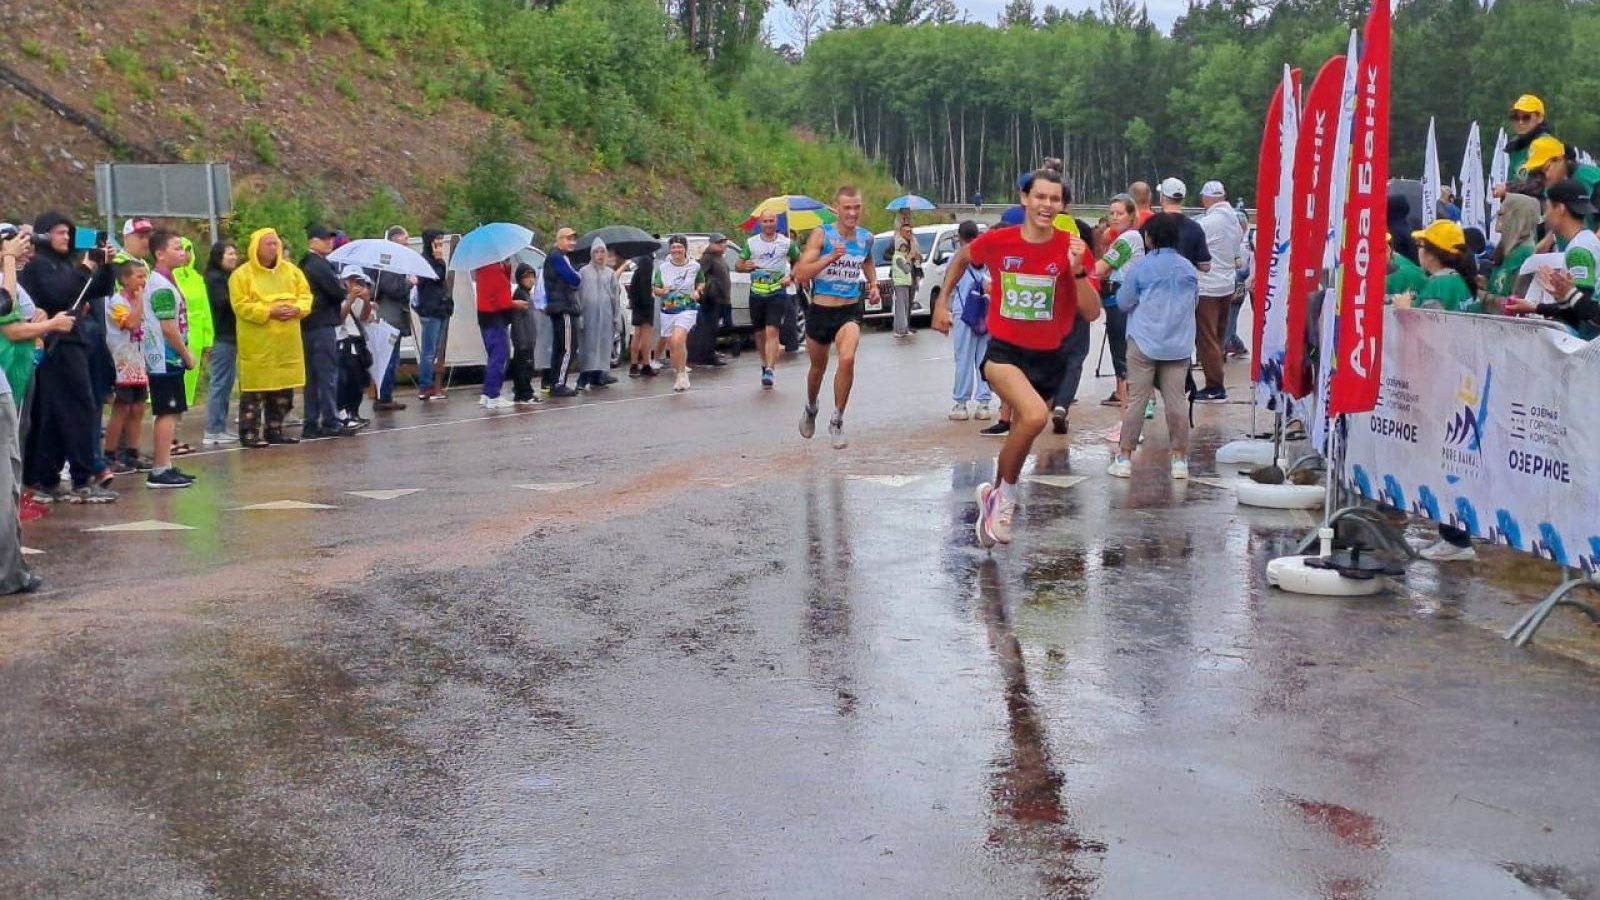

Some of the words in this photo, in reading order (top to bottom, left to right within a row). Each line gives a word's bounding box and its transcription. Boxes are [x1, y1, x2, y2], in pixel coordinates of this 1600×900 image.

[1358, 63, 1378, 194] Банк
[1006, 288, 1047, 309] 932
[1370, 414, 1418, 444] ОЗЕРНОЕ
[1509, 449, 1570, 484] ОЗЕРНОЕ
